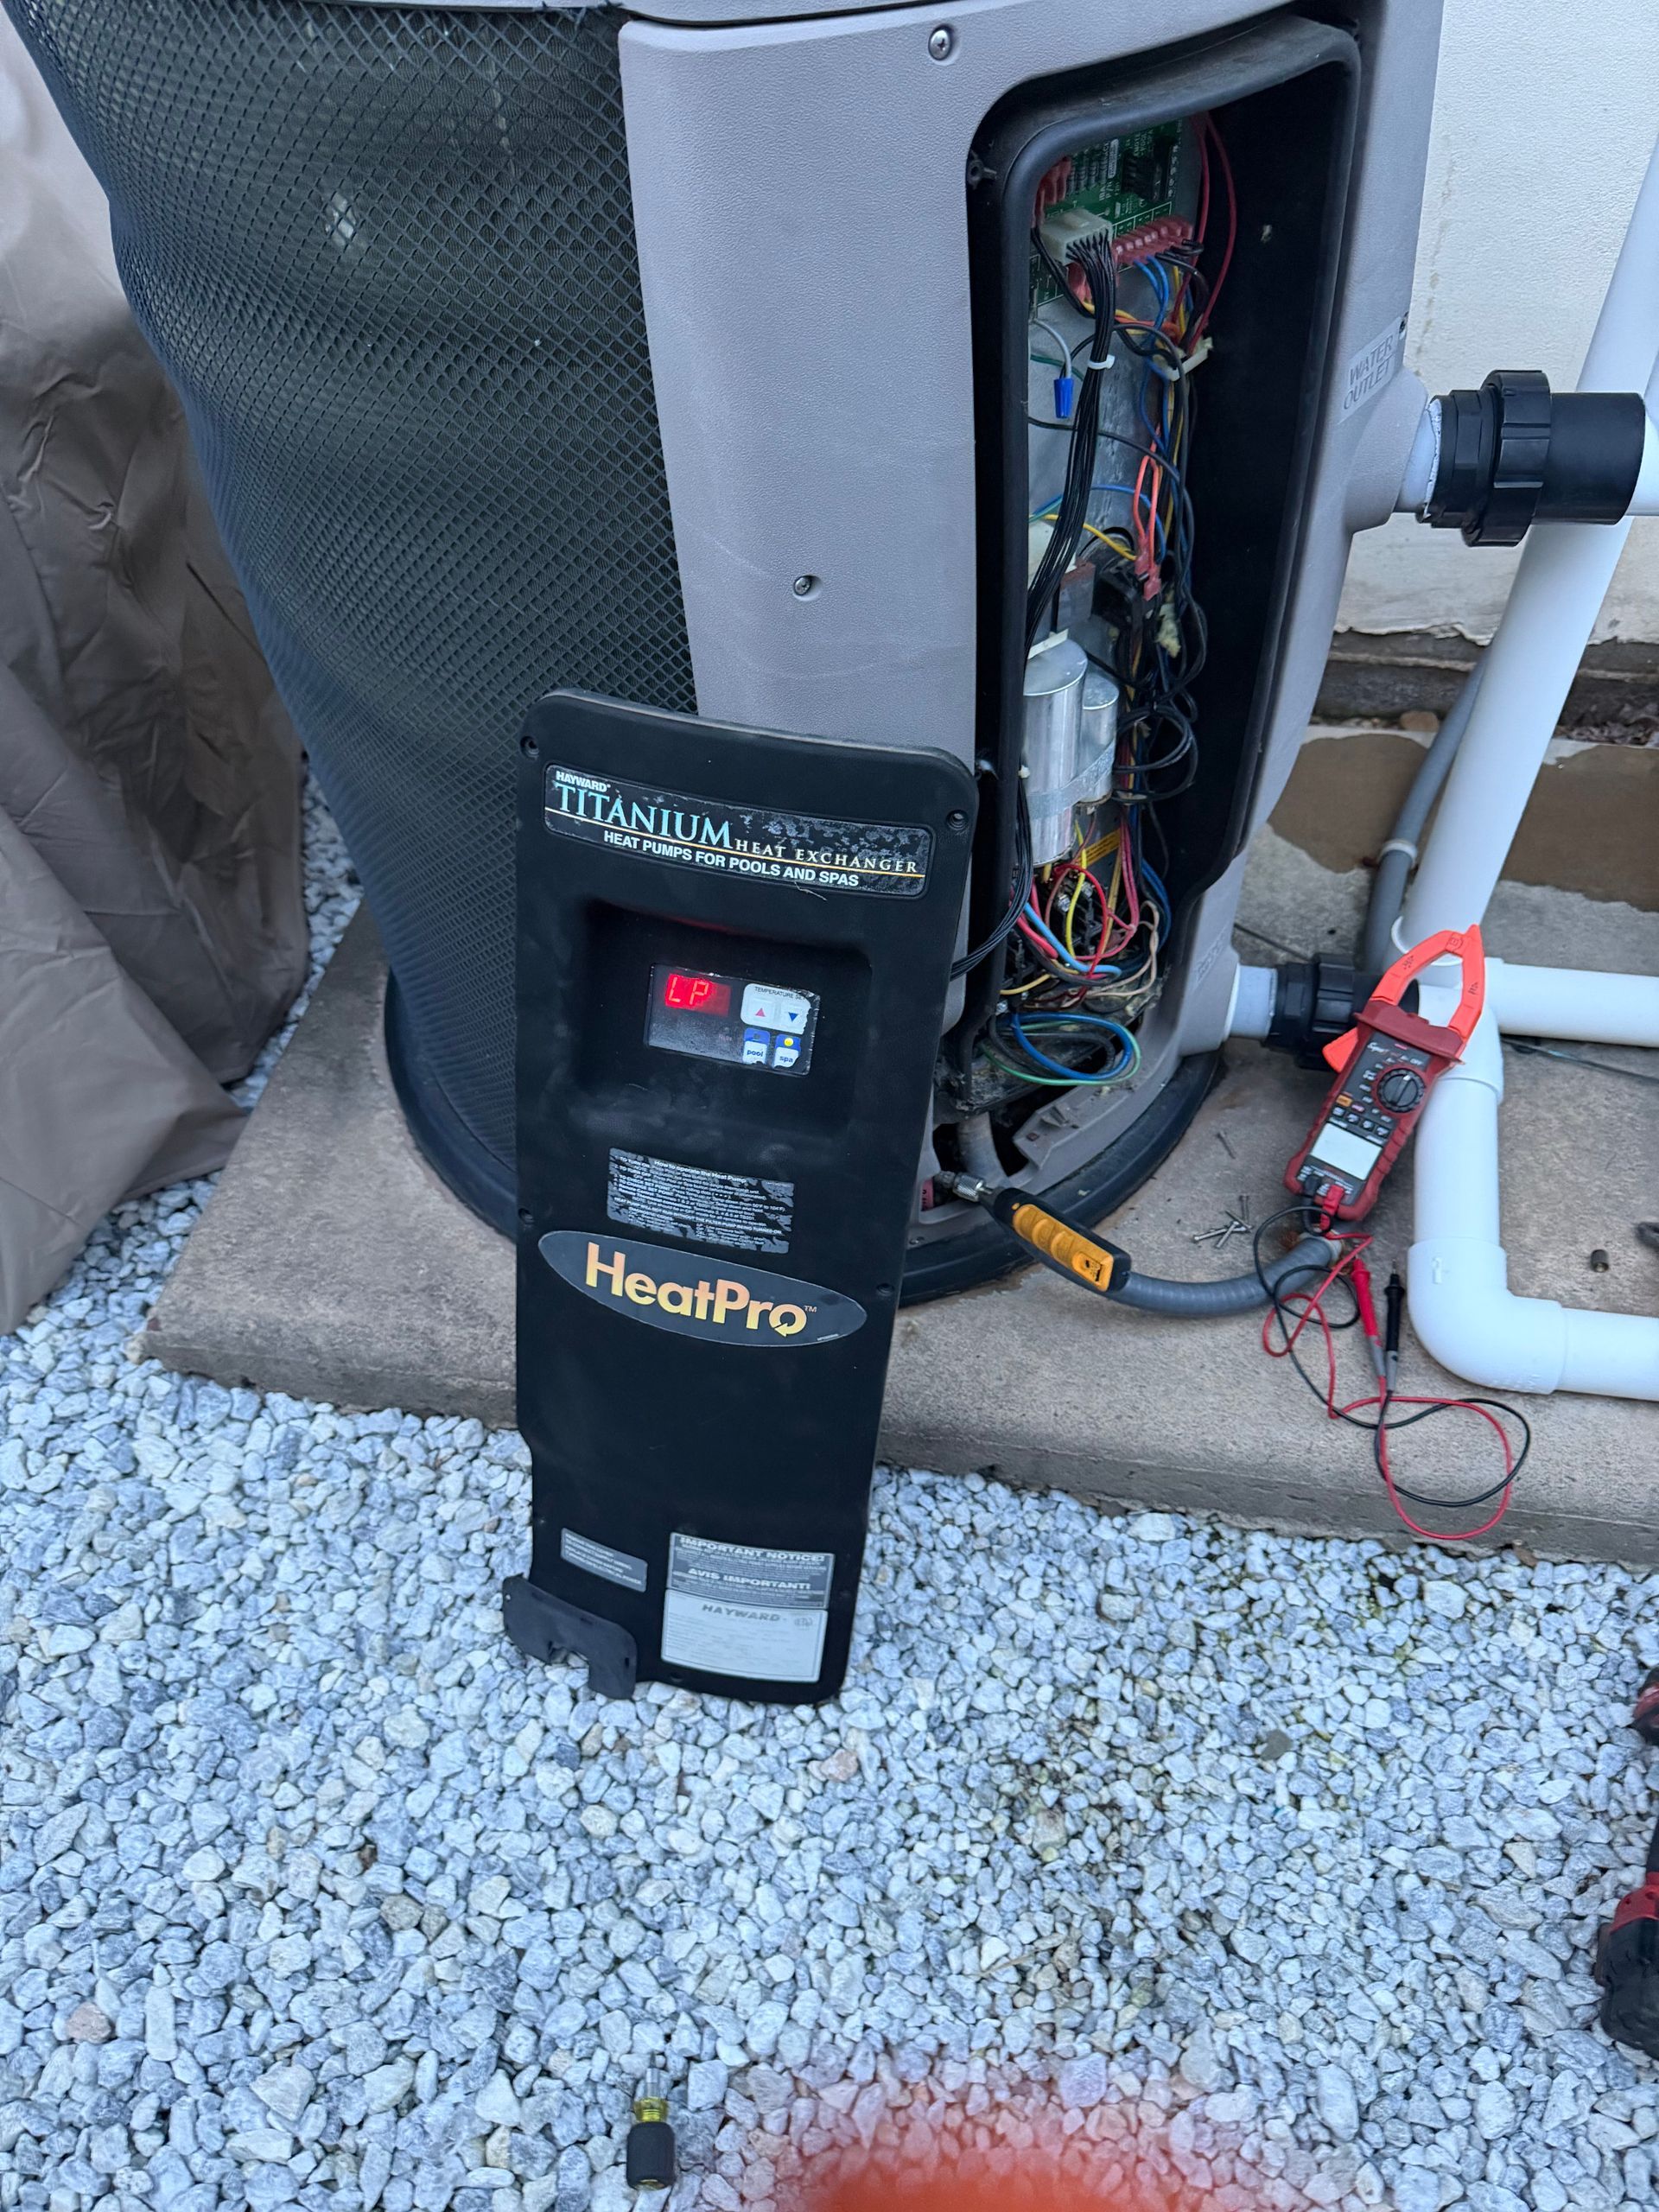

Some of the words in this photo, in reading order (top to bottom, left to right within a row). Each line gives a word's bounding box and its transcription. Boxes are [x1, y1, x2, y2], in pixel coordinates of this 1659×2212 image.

[1350, 335, 1393, 385] WATER
[1344, 353, 1395, 410] OUTLET
[553, 780, 733, 849] TITANIUM
[604, 830, 640, 849] HEAT
[642, 839, 692, 861] PUMPS
[695, 850, 726, 868] FOR
[728, 857, 781, 876] POOLS
[783, 867, 816, 881] AND
[819, 871, 859, 887] SPAS
[735, 838, 785, 858] HEAT
[796, 849, 918, 873] EXCHANGER
[668, 976, 709, 1005] LP
[754, 986, 794, 998] TEMPERATURE
[676, 1166, 700, 1175] operate
[727, 1174, 747, 1184] Pump
[680, 1536, 766, 1557] IMPORTANT
[766, 1550, 825, 1562] NOTICE!
[689, 1567, 721, 1580] AVIS
[723, 1573, 811, 1590] IMPORTANT!
[702, 1604, 780, 1622] HAYWARD
